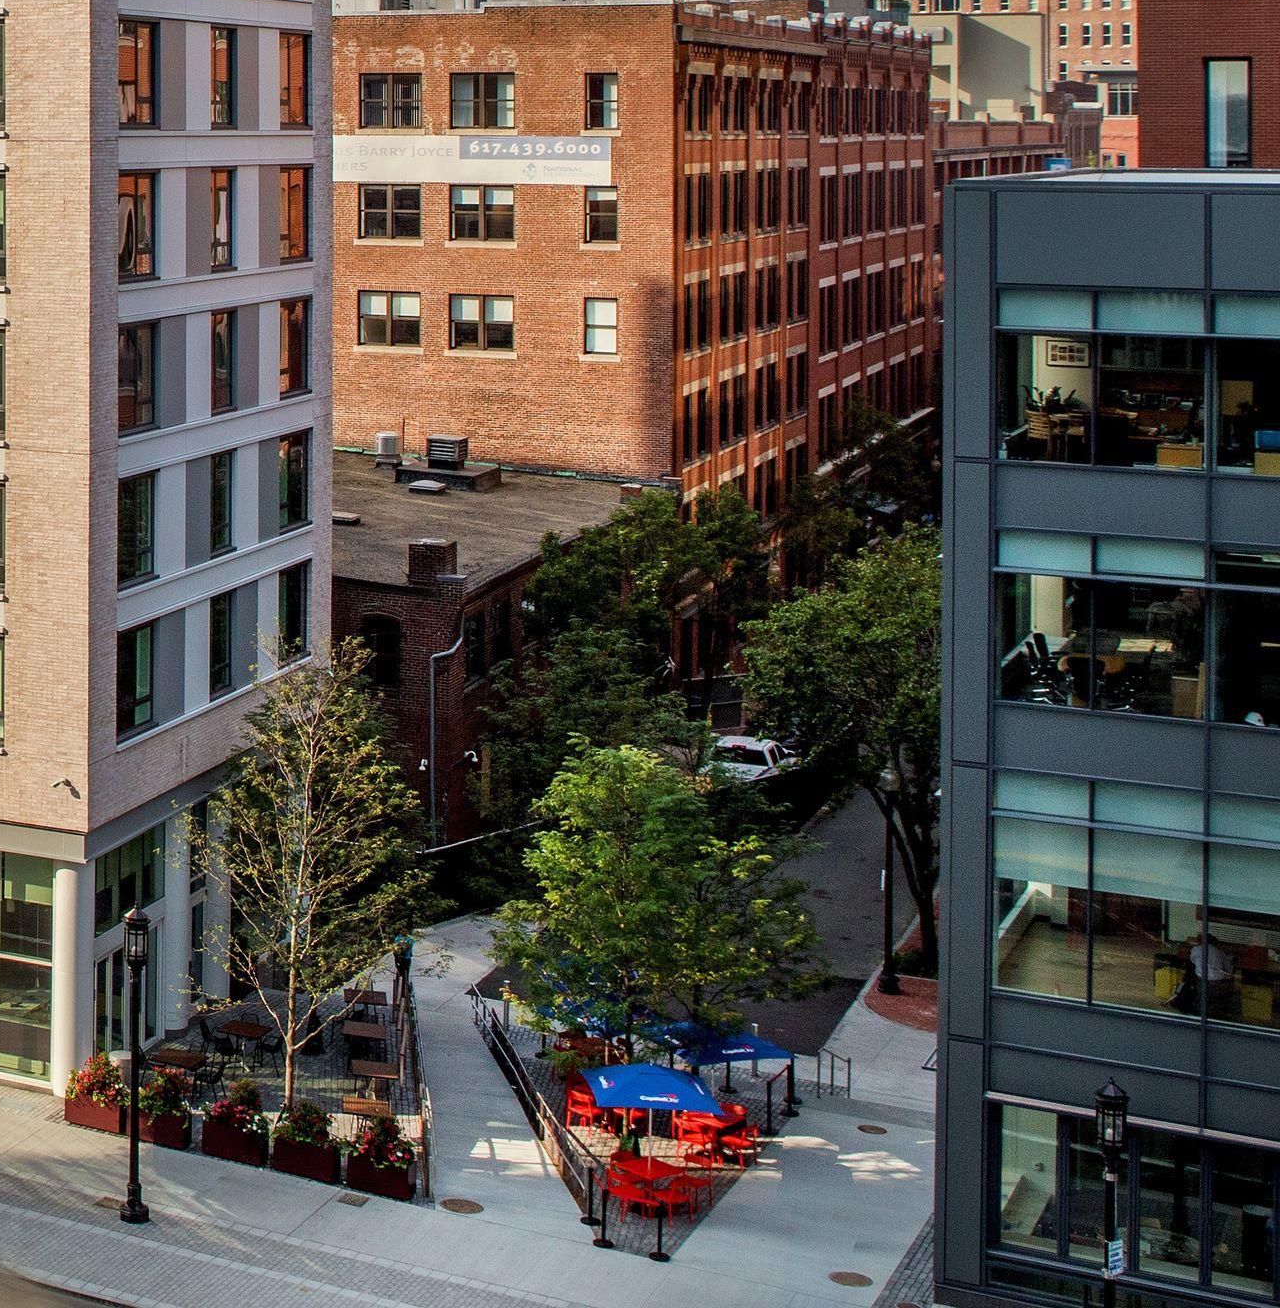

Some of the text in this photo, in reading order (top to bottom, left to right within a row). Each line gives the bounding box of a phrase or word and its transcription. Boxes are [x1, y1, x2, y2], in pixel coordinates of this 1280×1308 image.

[359, 145, 407, 157] BARRY
[411, 145, 453, 158] JOYCE
[469, 140, 602, 156] 617.439.6000
